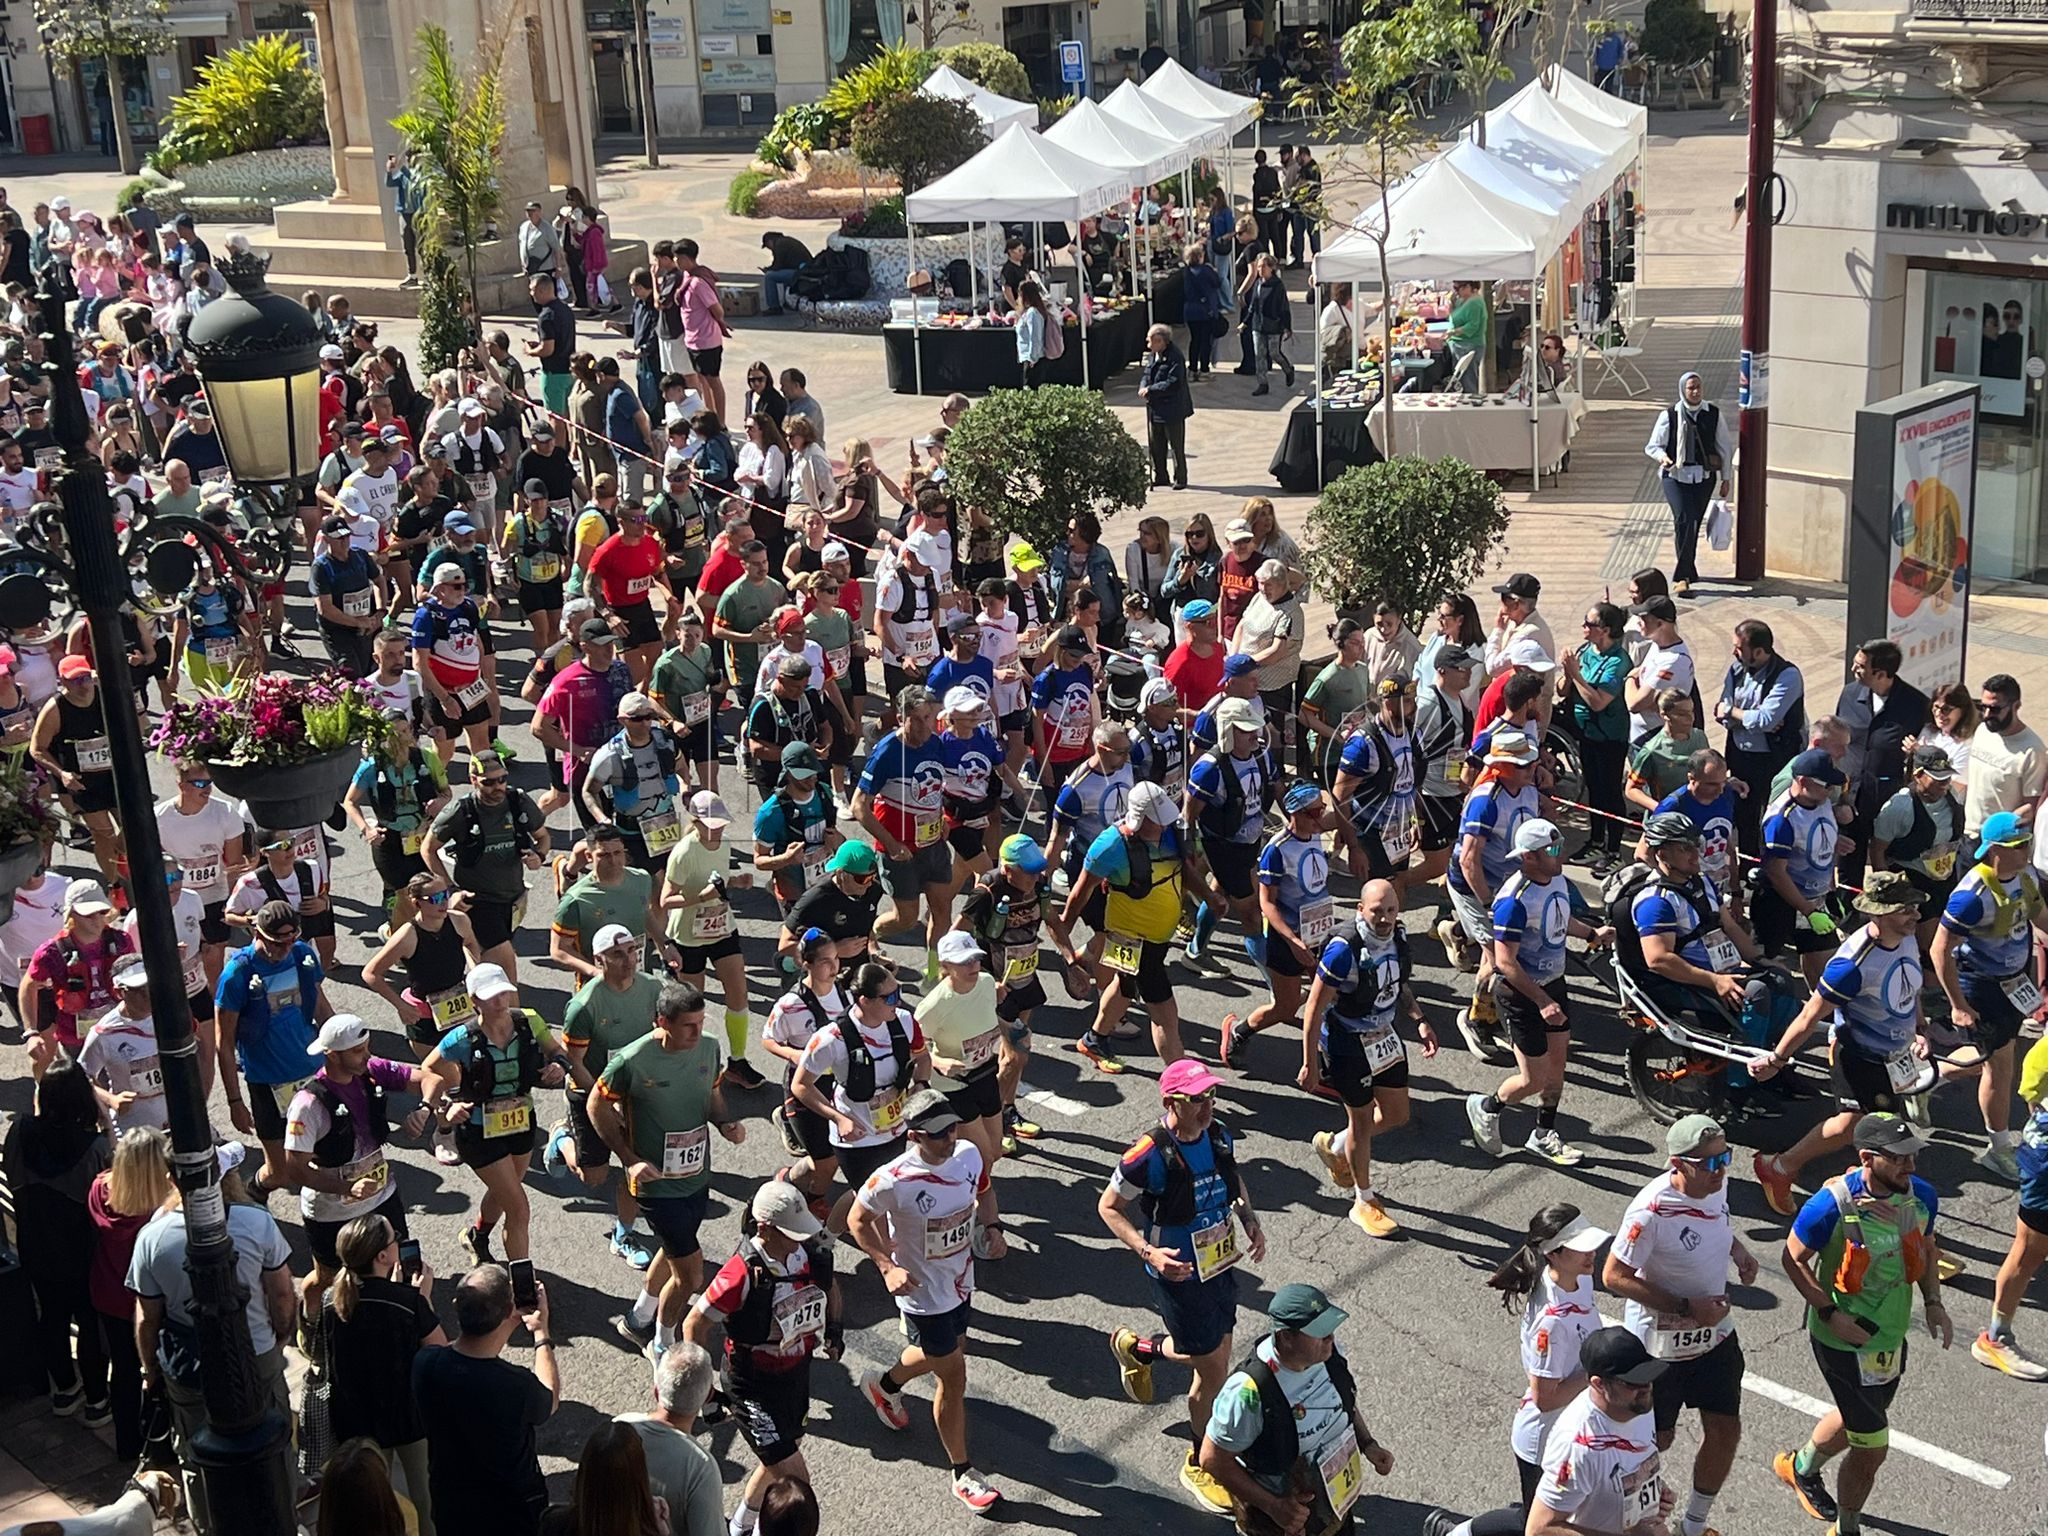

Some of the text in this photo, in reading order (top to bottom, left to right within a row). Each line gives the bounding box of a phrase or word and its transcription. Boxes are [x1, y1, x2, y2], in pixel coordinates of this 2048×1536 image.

[658, 826, 678, 842] 331
[189, 866, 216, 881] 1884
[1310, 917, 1333, 935] 2753
[447, 996, 467, 1014] 288
[502, 1109, 524, 1127] 913
[1673, 1329, 1711, 1347] 1549
